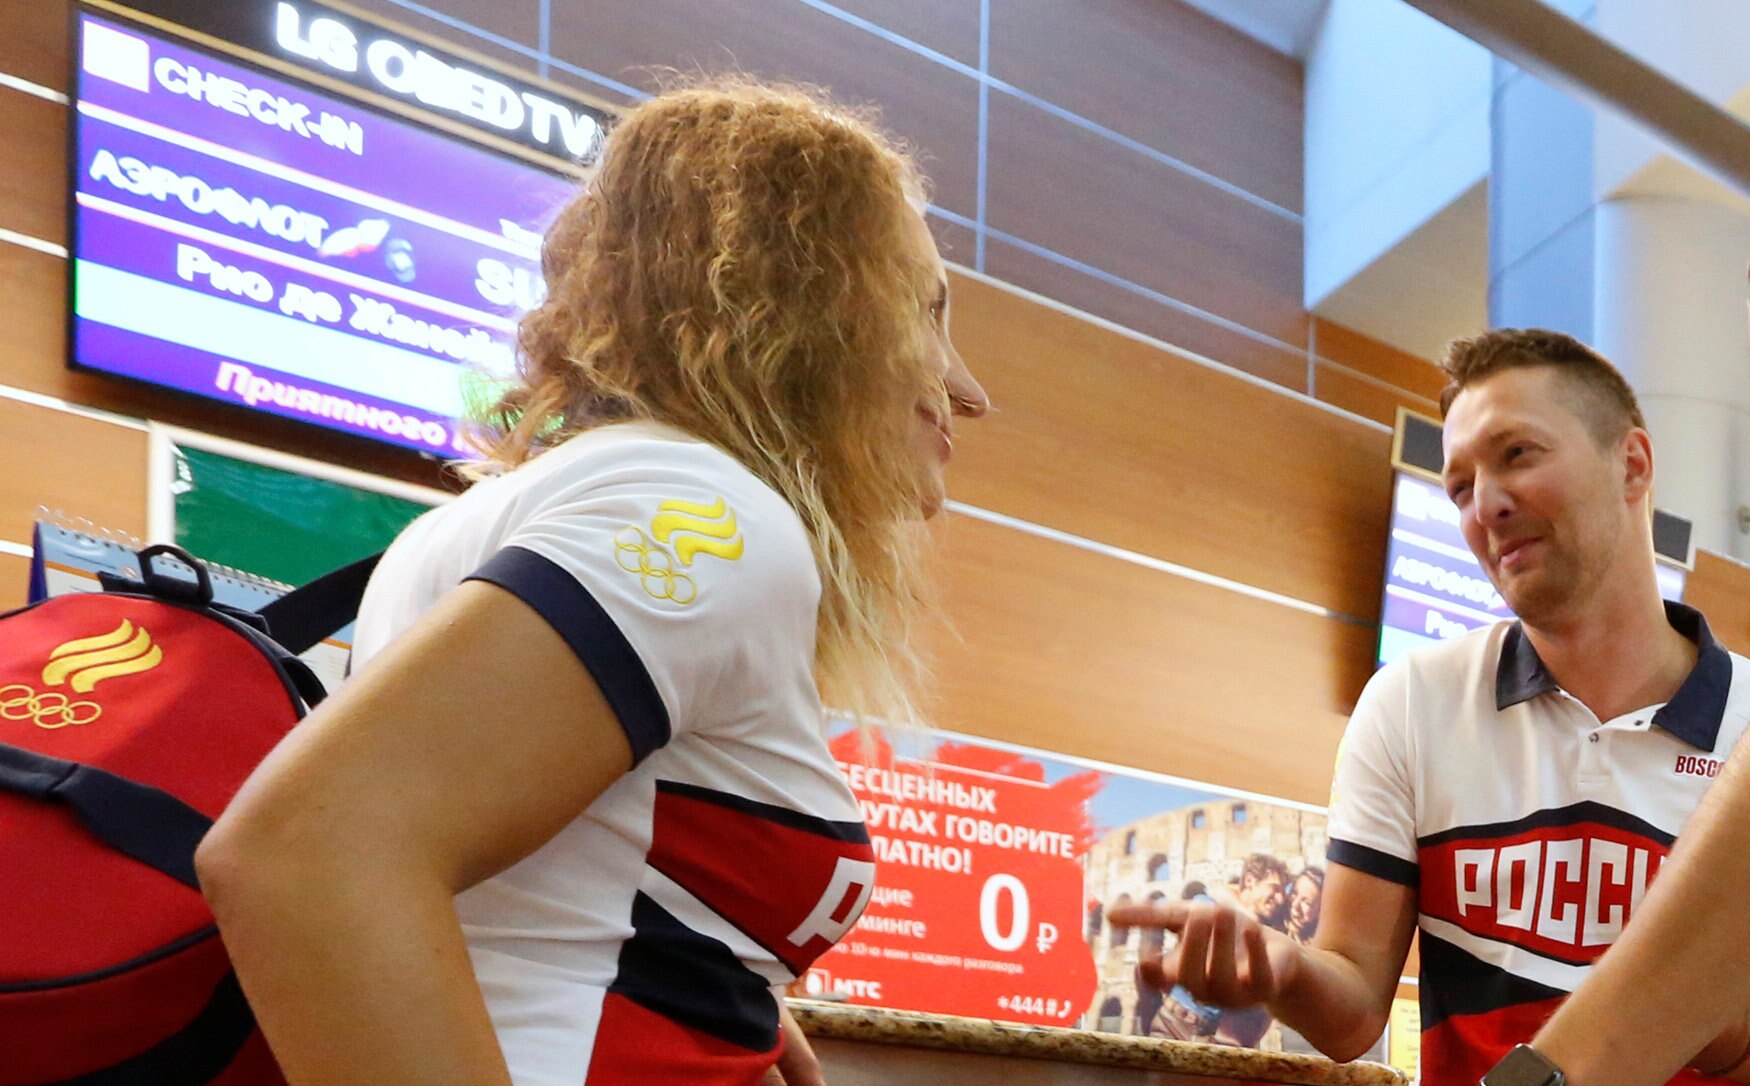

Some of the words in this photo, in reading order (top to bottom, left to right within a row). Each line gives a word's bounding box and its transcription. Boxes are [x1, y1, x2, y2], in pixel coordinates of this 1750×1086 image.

[154, 57, 364, 155] CHECK-IN
[276, 2, 358, 72] LG
[522, 92, 602, 158] TV
[89, 149, 329, 249] АЭРОФЛОТ
[177, 243, 274, 303] Рио
[279, 282, 343, 323] де
[215, 361, 448, 447] Приятного
[945, 812, 1075, 859] ГОВОРИТЕ
[979, 872, 1030, 952] 0
